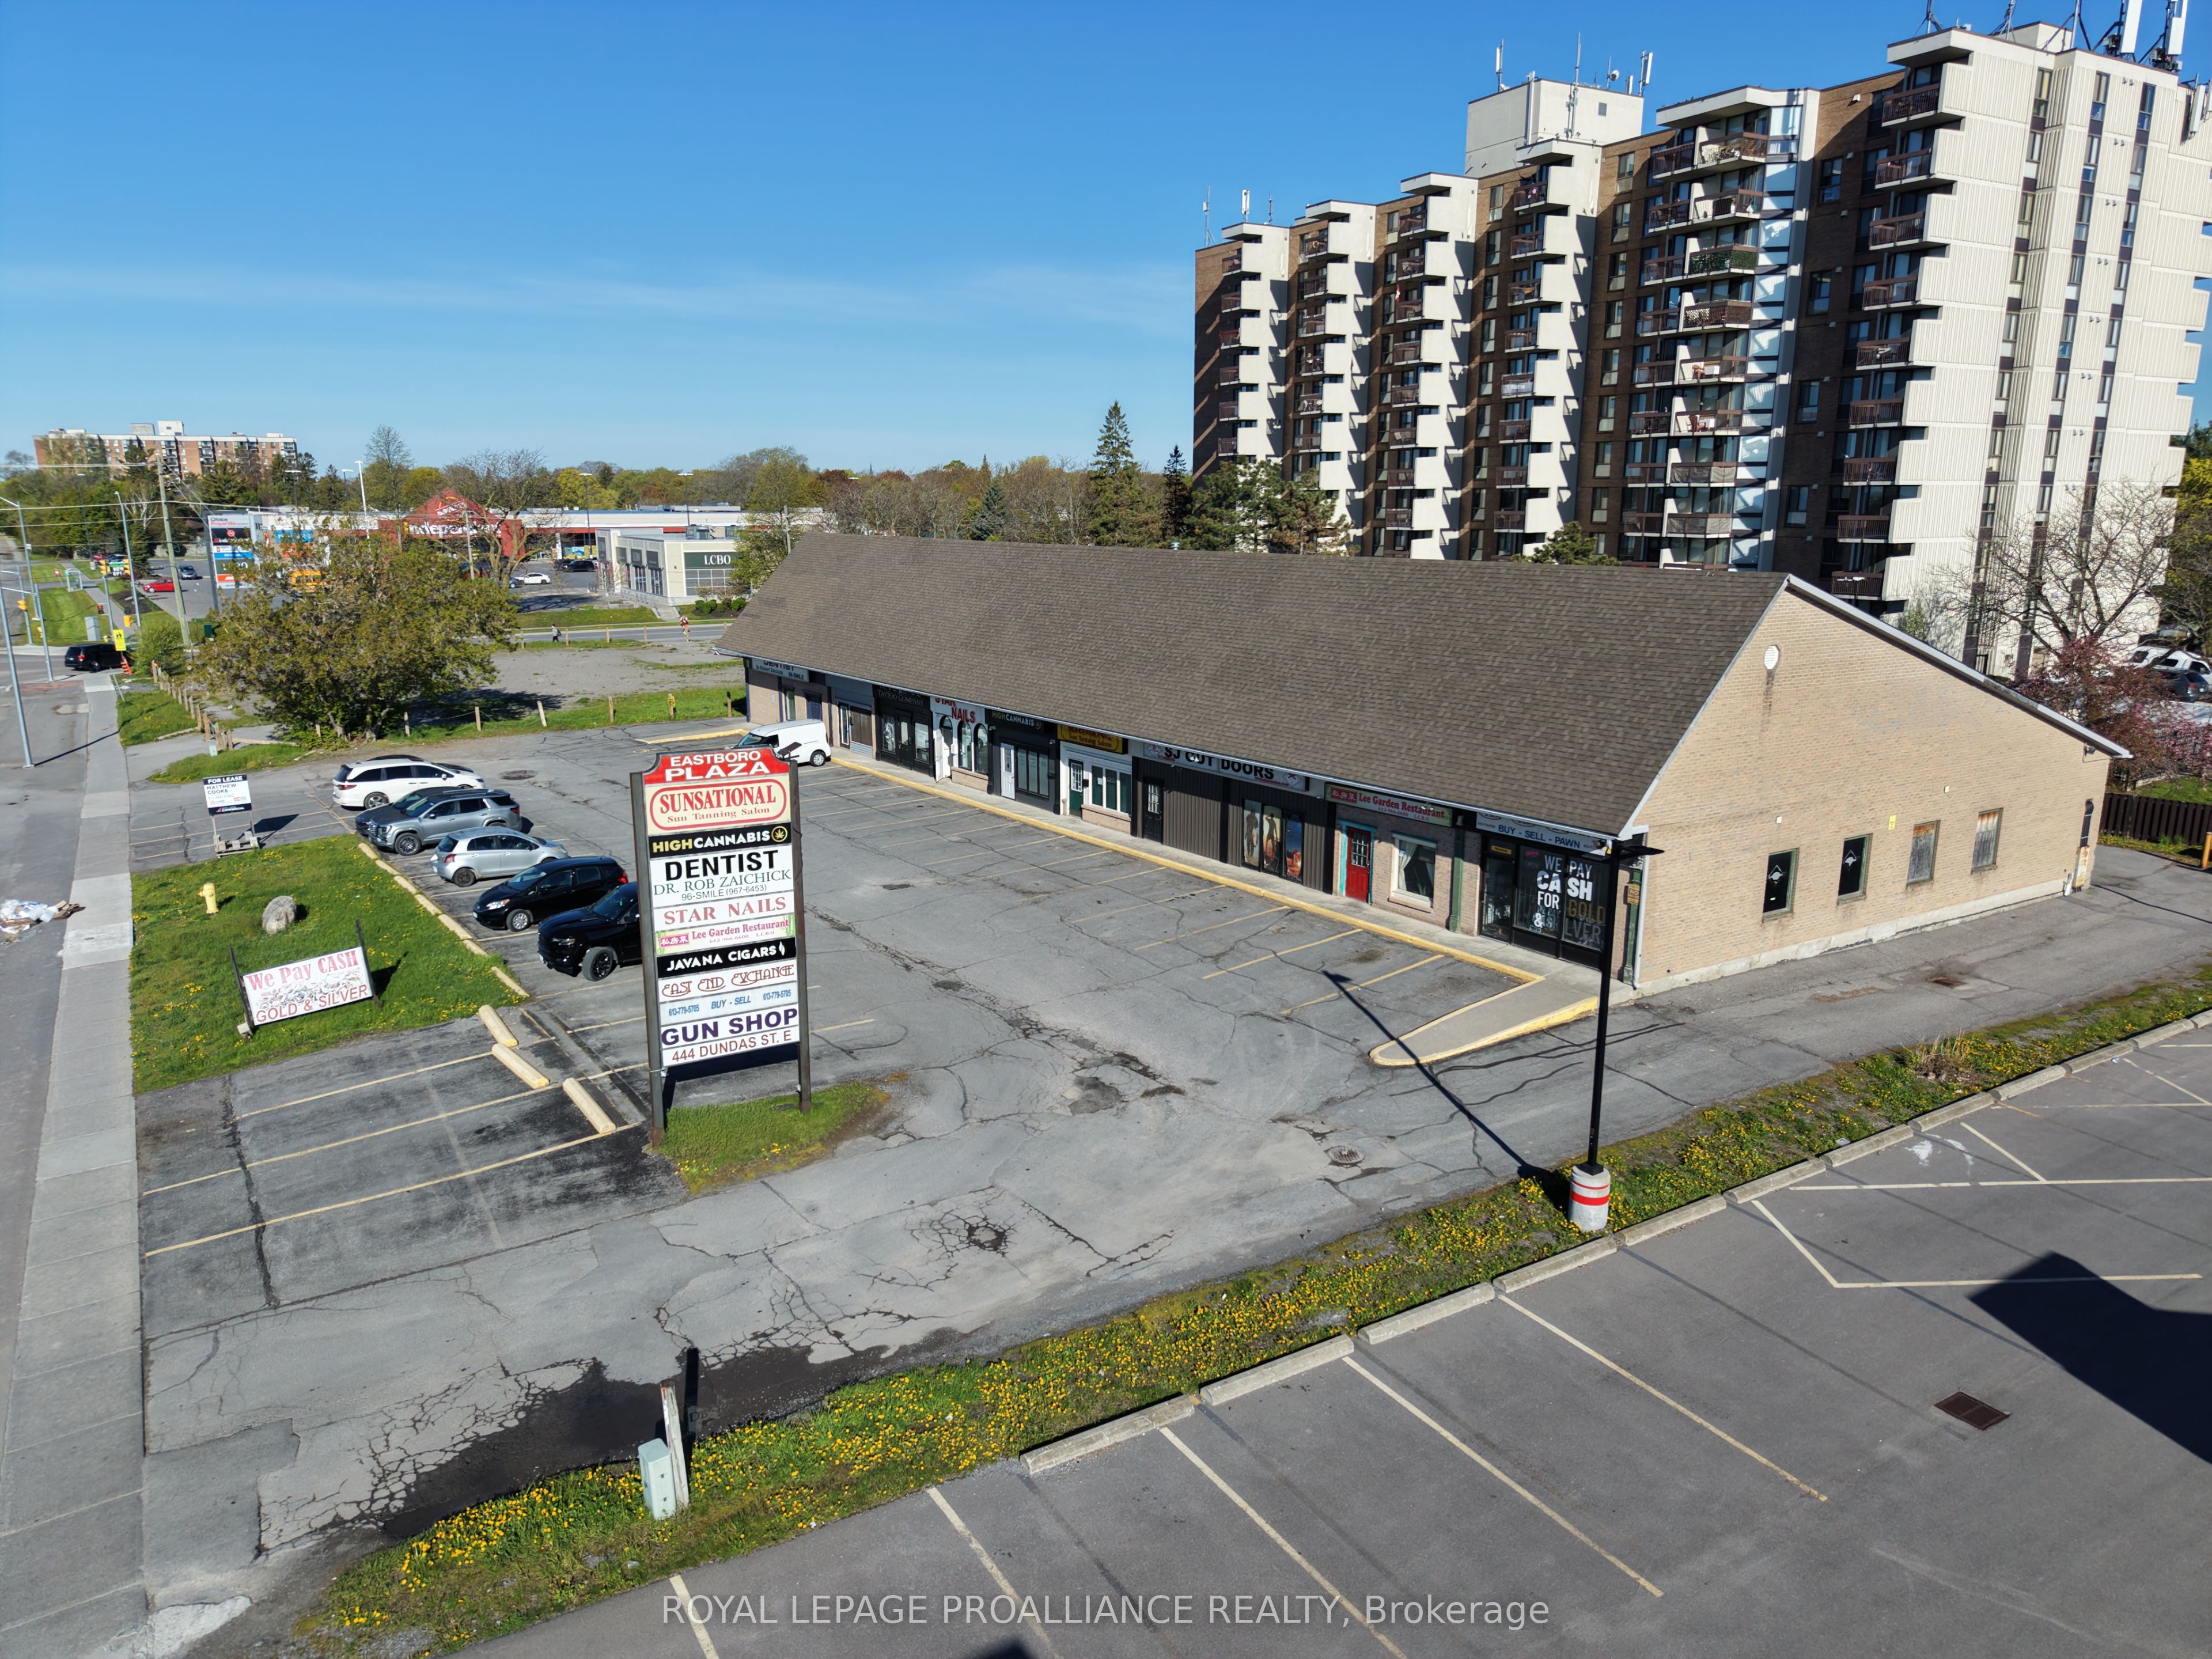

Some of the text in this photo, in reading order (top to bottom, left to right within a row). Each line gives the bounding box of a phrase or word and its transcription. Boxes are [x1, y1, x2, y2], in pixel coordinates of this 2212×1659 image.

[704, 554, 731, 565] LCBO
[878, 691, 897, 701] TATTOO
[898, 694, 925, 706] COMPANY
[951, 706, 976, 724] NAILS
[670, 750, 762, 767] EASTBORO
[1164, 747, 1180, 759] SJ
[1221, 758, 1274, 779] DOORS
[665, 762, 771, 782] PLAZA
[660, 785, 777, 814] SUNSATIONAL
[1359, 793, 1445, 819] Lee Garden Restaurant
[667, 807, 770, 823] Sun Tanning Salon
[1498, 824, 1516, 835] BUY
[1525, 830, 1546, 841] SELL
[1555, 836, 1581, 849] PAWN
[665, 849, 779, 881] DENTIST
[1544, 854, 1593, 880] WE PAY
[653, 869, 793, 896] DR. ROB ZAICHICK
[681, 884, 767, 902] 96-SMILE (967-6453)
[1536, 870, 1593, 902] CASH
[664, 896, 787, 926] STAR NAILS
[1533, 912, 1543, 928] &
[1537, 891, 1606, 926] FOR GOLD
[691, 919, 790, 940] Lee Garden Restaurant
[245, 950, 359, 991] We Pay CASH
[666, 945, 777, 971] JAVANA CIGARS
[661, 964, 795, 998] EAST END EXCHANGE
[255, 983, 368, 1022] GOLD & SILVER
[668, 1004, 700, 1017] 613-779-5705
[710, 999, 728, 1010] BUY
[734, 995, 752, 1006] SELL
[763, 989, 792, 1001] 613-779-5705
[661, 1007, 798, 1046] GUN SHOP
[672, 1029, 793, 1062] 444 DUNDAS ST. E
